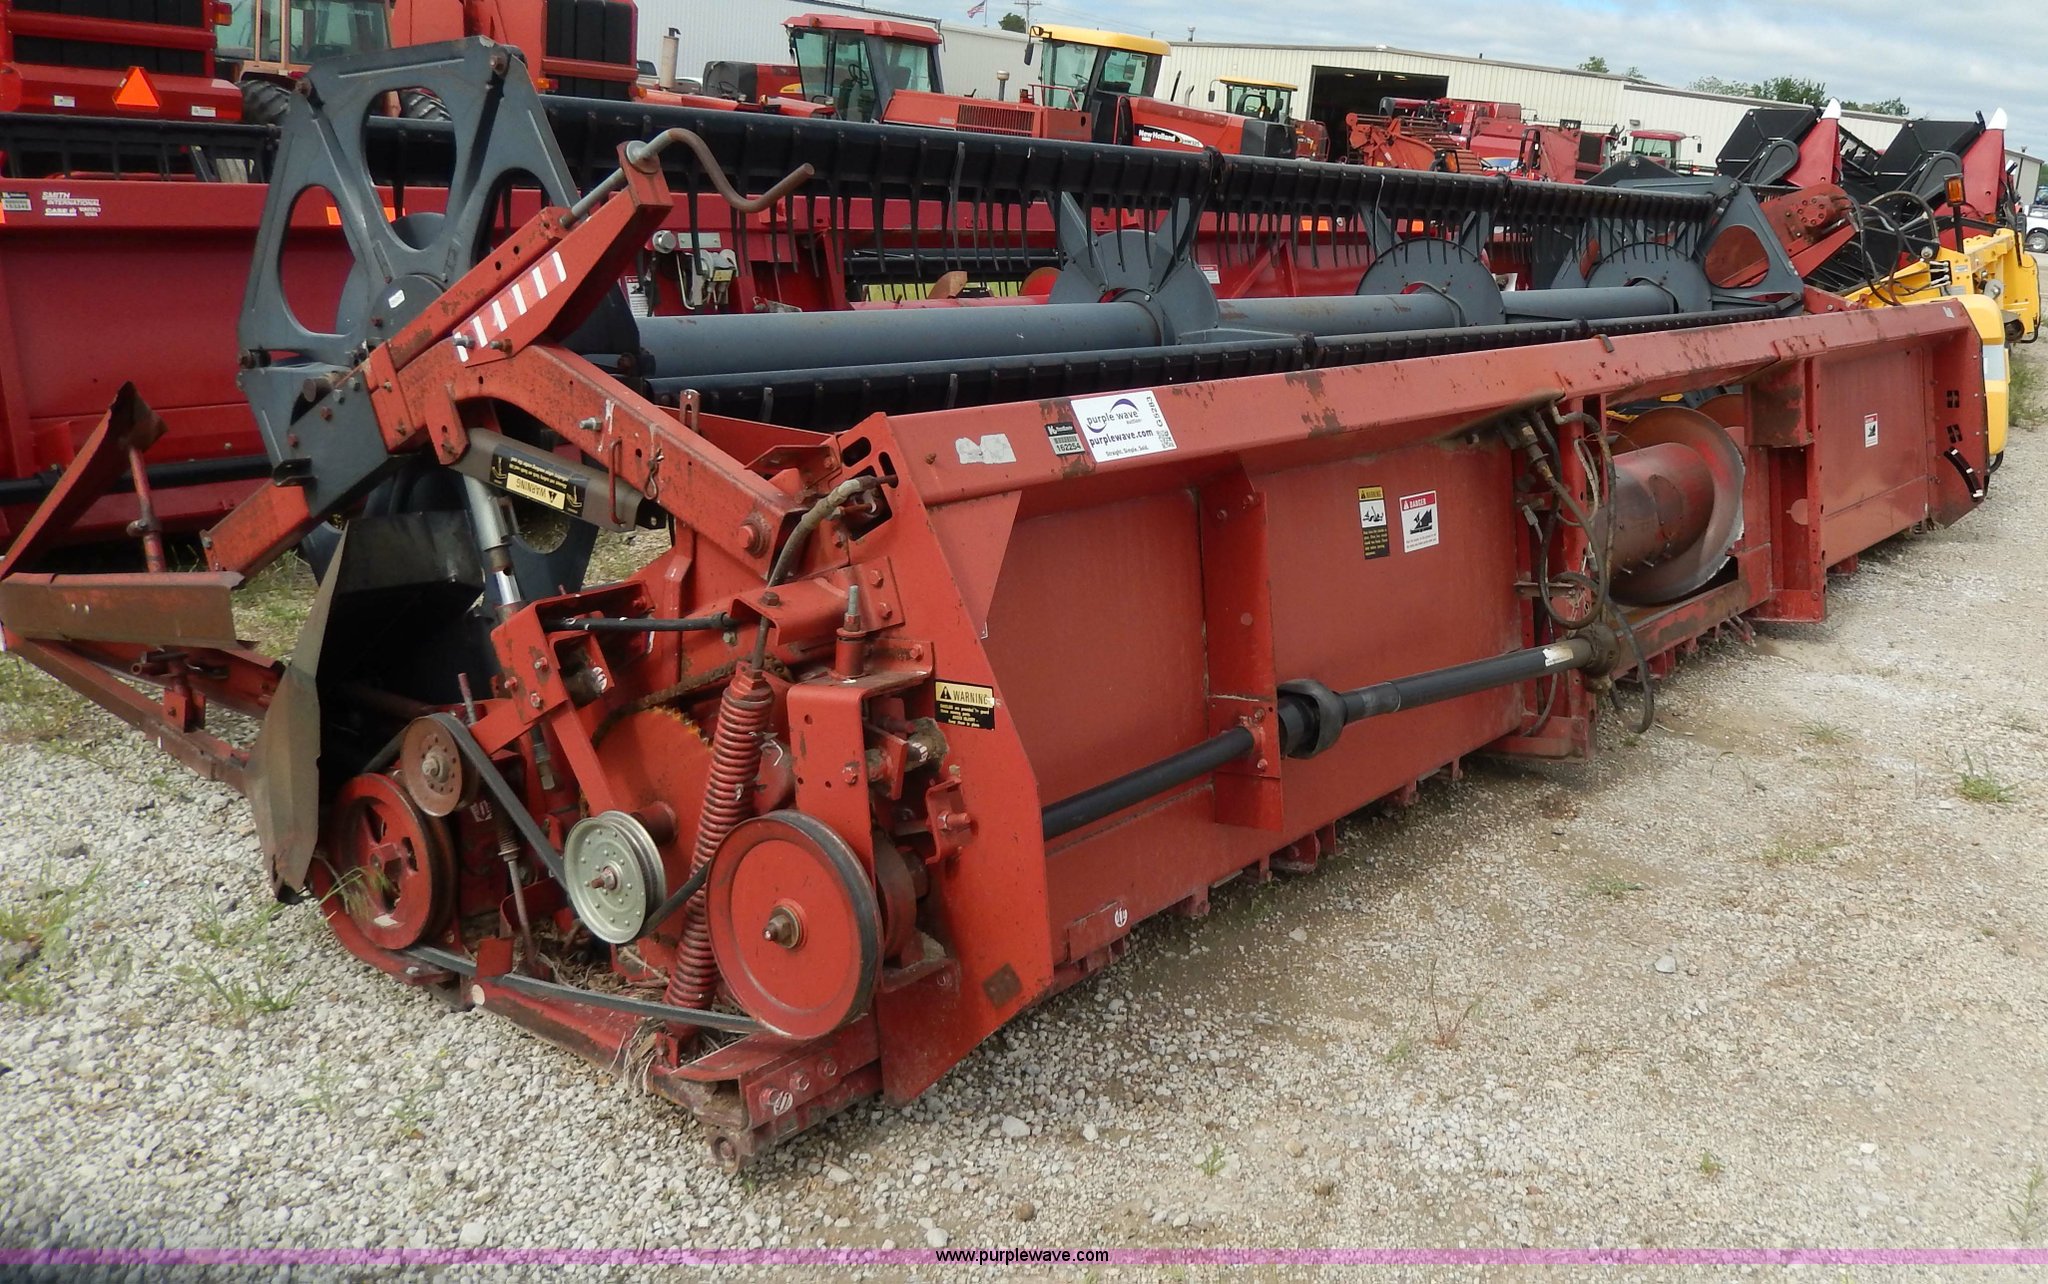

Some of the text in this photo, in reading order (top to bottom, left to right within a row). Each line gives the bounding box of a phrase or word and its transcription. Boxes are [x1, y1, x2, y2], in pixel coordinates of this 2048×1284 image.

[1139, 130, 1152, 138] New
[1153, 132, 1176, 142] Holland
[42, 191, 71, 200] SMITH
[1086, 410, 1139, 426] purple wave
[1089, 429, 1153, 448] purplewave.com
[516, 479, 546, 498] WARNING
[1410, 498, 1426, 509] DANGER
